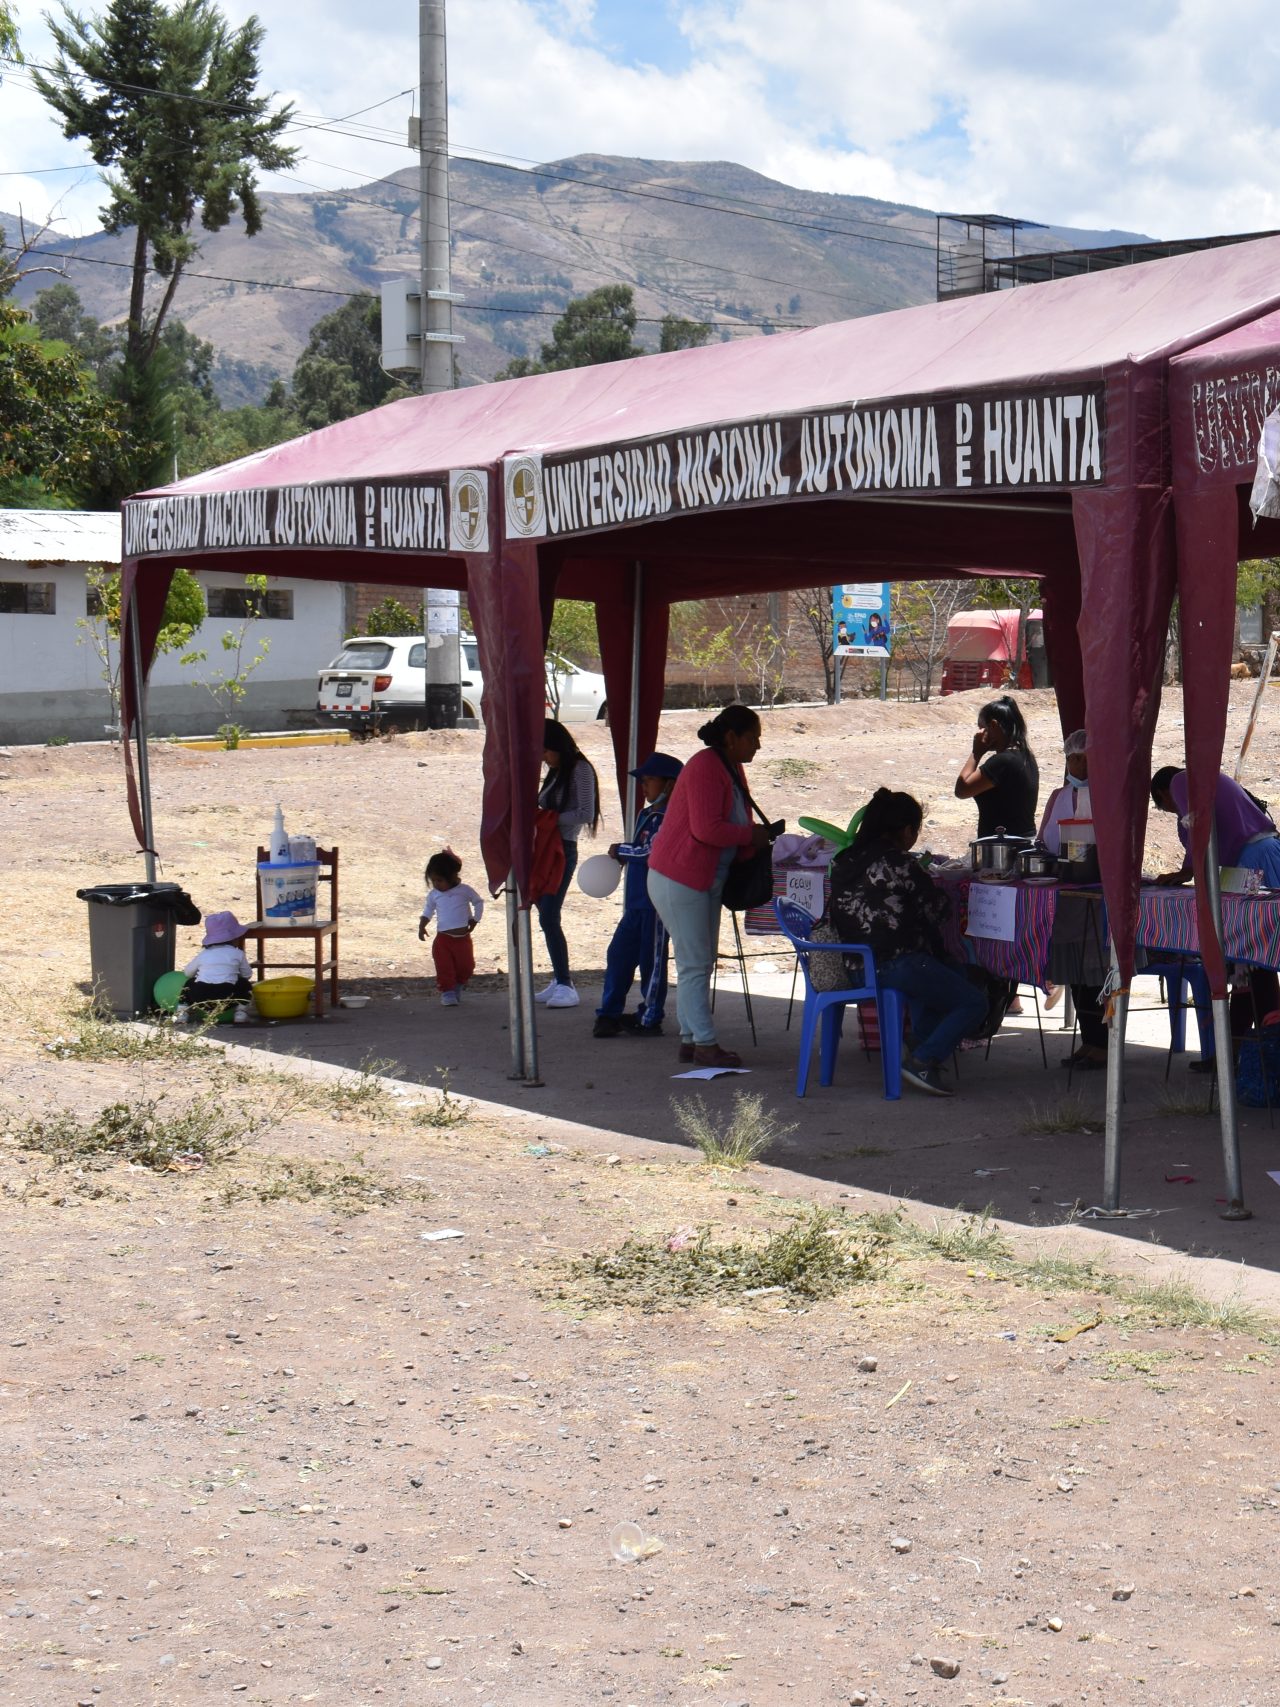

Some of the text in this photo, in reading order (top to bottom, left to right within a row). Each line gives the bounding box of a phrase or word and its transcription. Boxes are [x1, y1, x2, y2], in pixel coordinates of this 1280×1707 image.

[544, 443, 671, 534] UNIVERSIDAD
[677, 421, 791, 510] NACIONAL
[984, 394, 1101, 485] HUANTA
[125, 495, 201, 556] UNIVERSIDAD
[204, 489, 271, 547] NACIONAL
[381, 487, 446, 549] HUANTA
